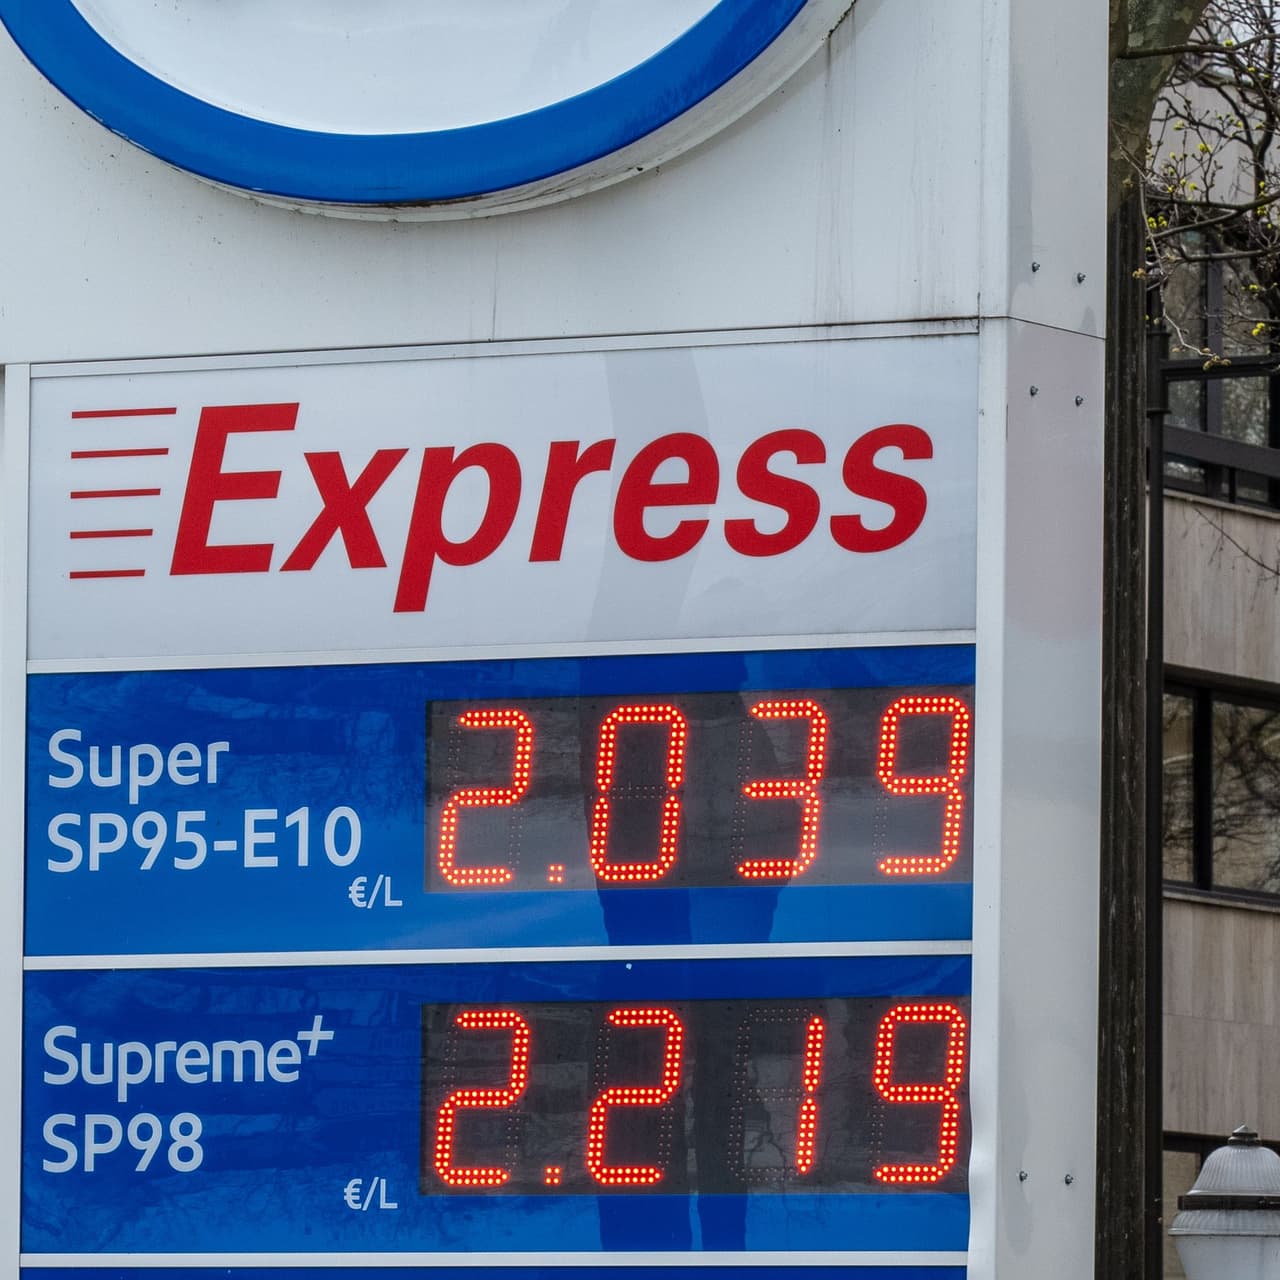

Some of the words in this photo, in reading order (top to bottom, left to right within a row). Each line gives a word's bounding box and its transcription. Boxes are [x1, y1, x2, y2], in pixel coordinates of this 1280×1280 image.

[171, 402, 933, 612] Express
[49, 729, 230, 805] Super
[436, 694, 969, 888] 2.039
[48, 806, 361, 873] SP95-E10
[348, 874, 403, 909] €/L
[432, 1002, 968, 1188] 2.219
[43, 1112, 204, 1174] SP98
[344, 1177, 398, 1211] €/L
